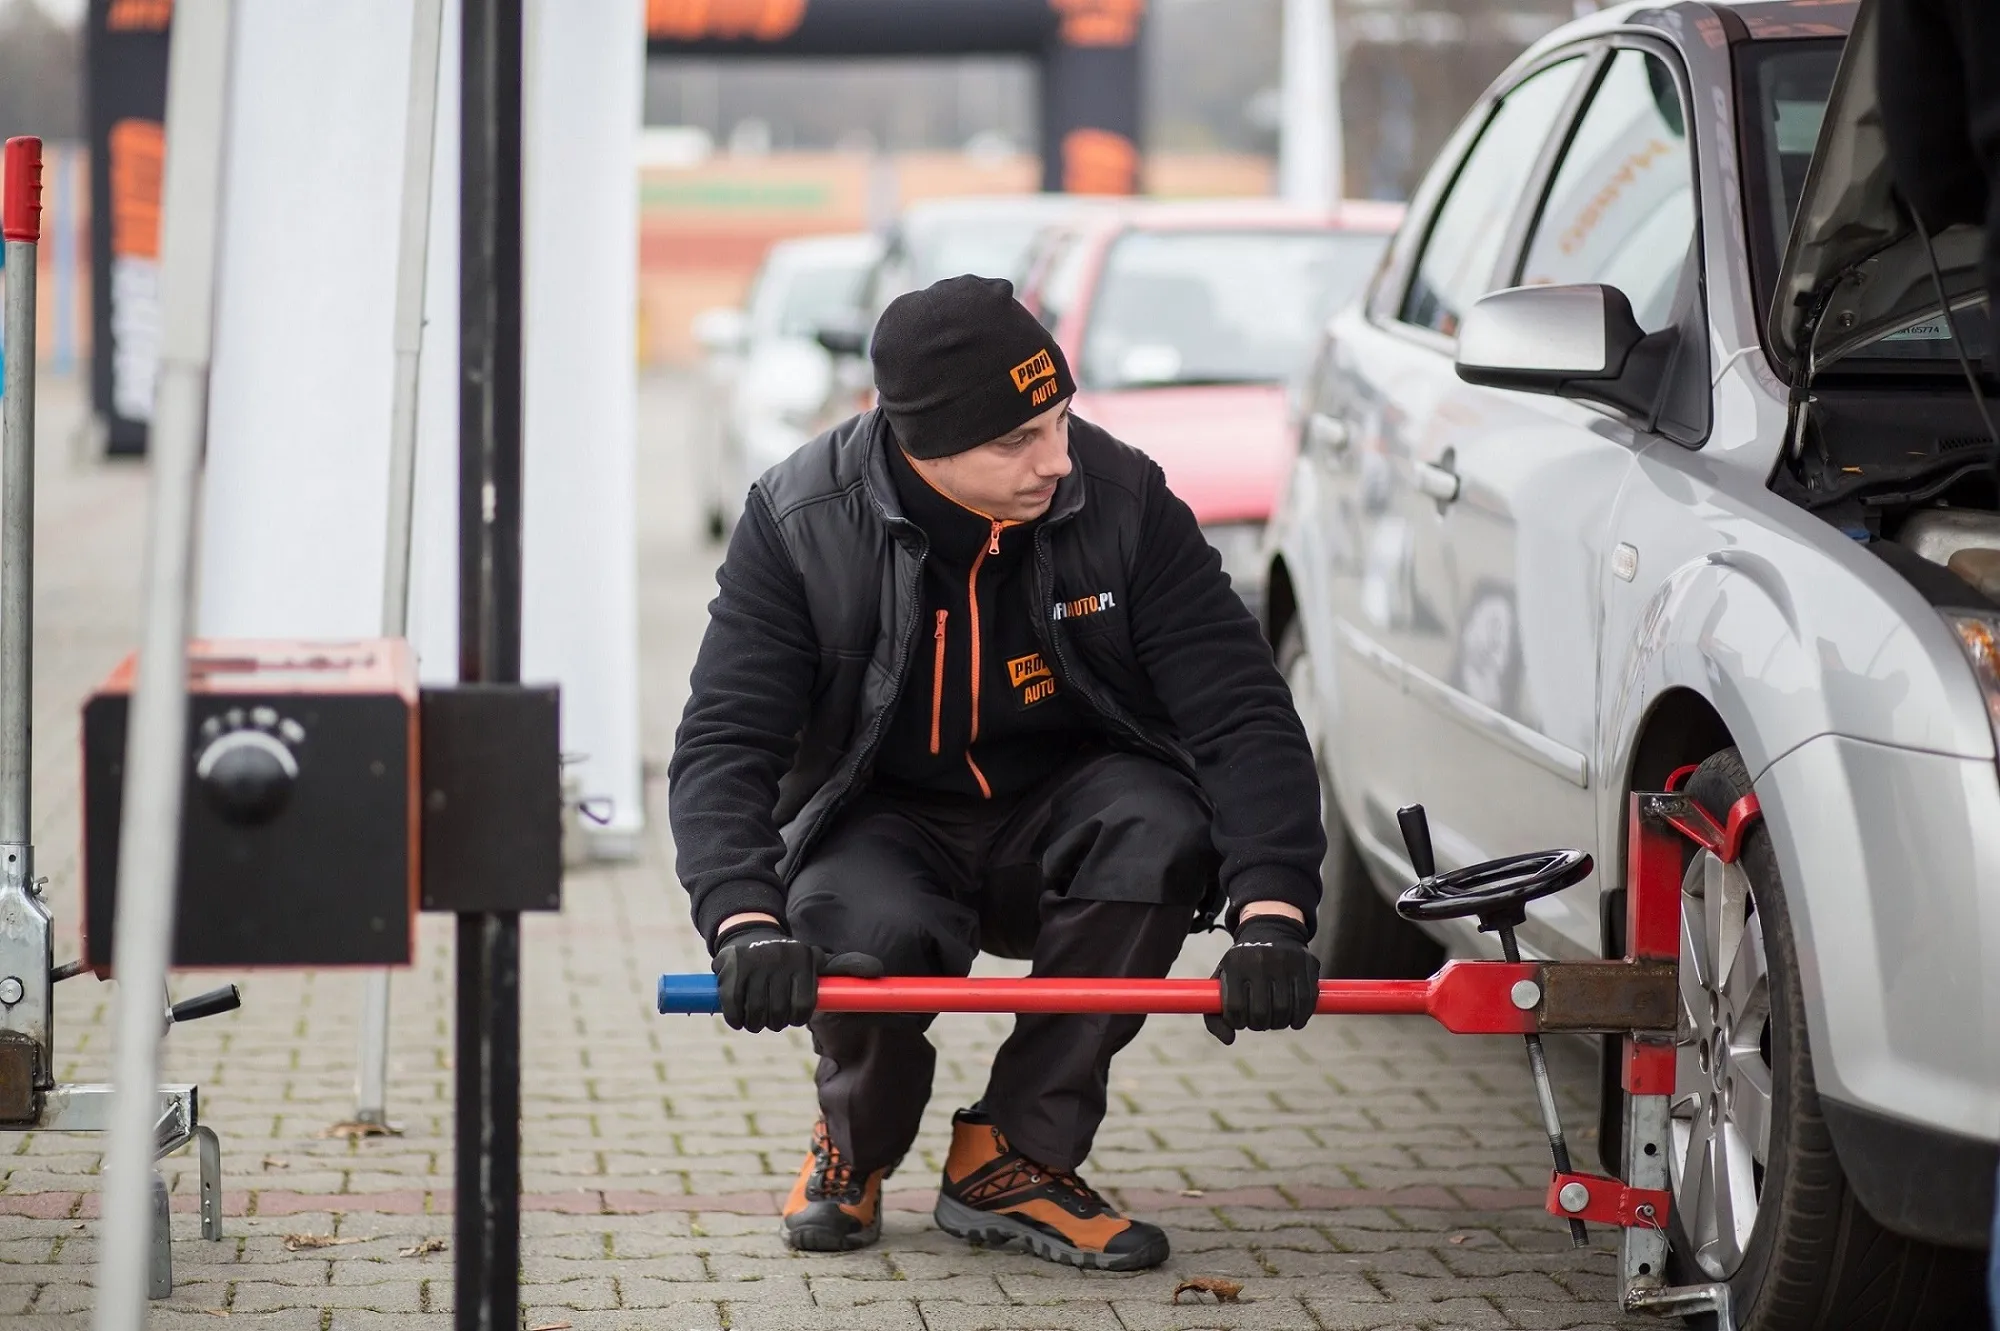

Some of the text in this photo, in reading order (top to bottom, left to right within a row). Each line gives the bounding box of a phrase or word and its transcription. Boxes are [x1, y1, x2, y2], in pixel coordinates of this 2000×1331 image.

[1016, 352, 1050, 385] PROFI
[1032, 377, 1058, 407] AUTO
[1024, 677, 1054, 705] AUTO
